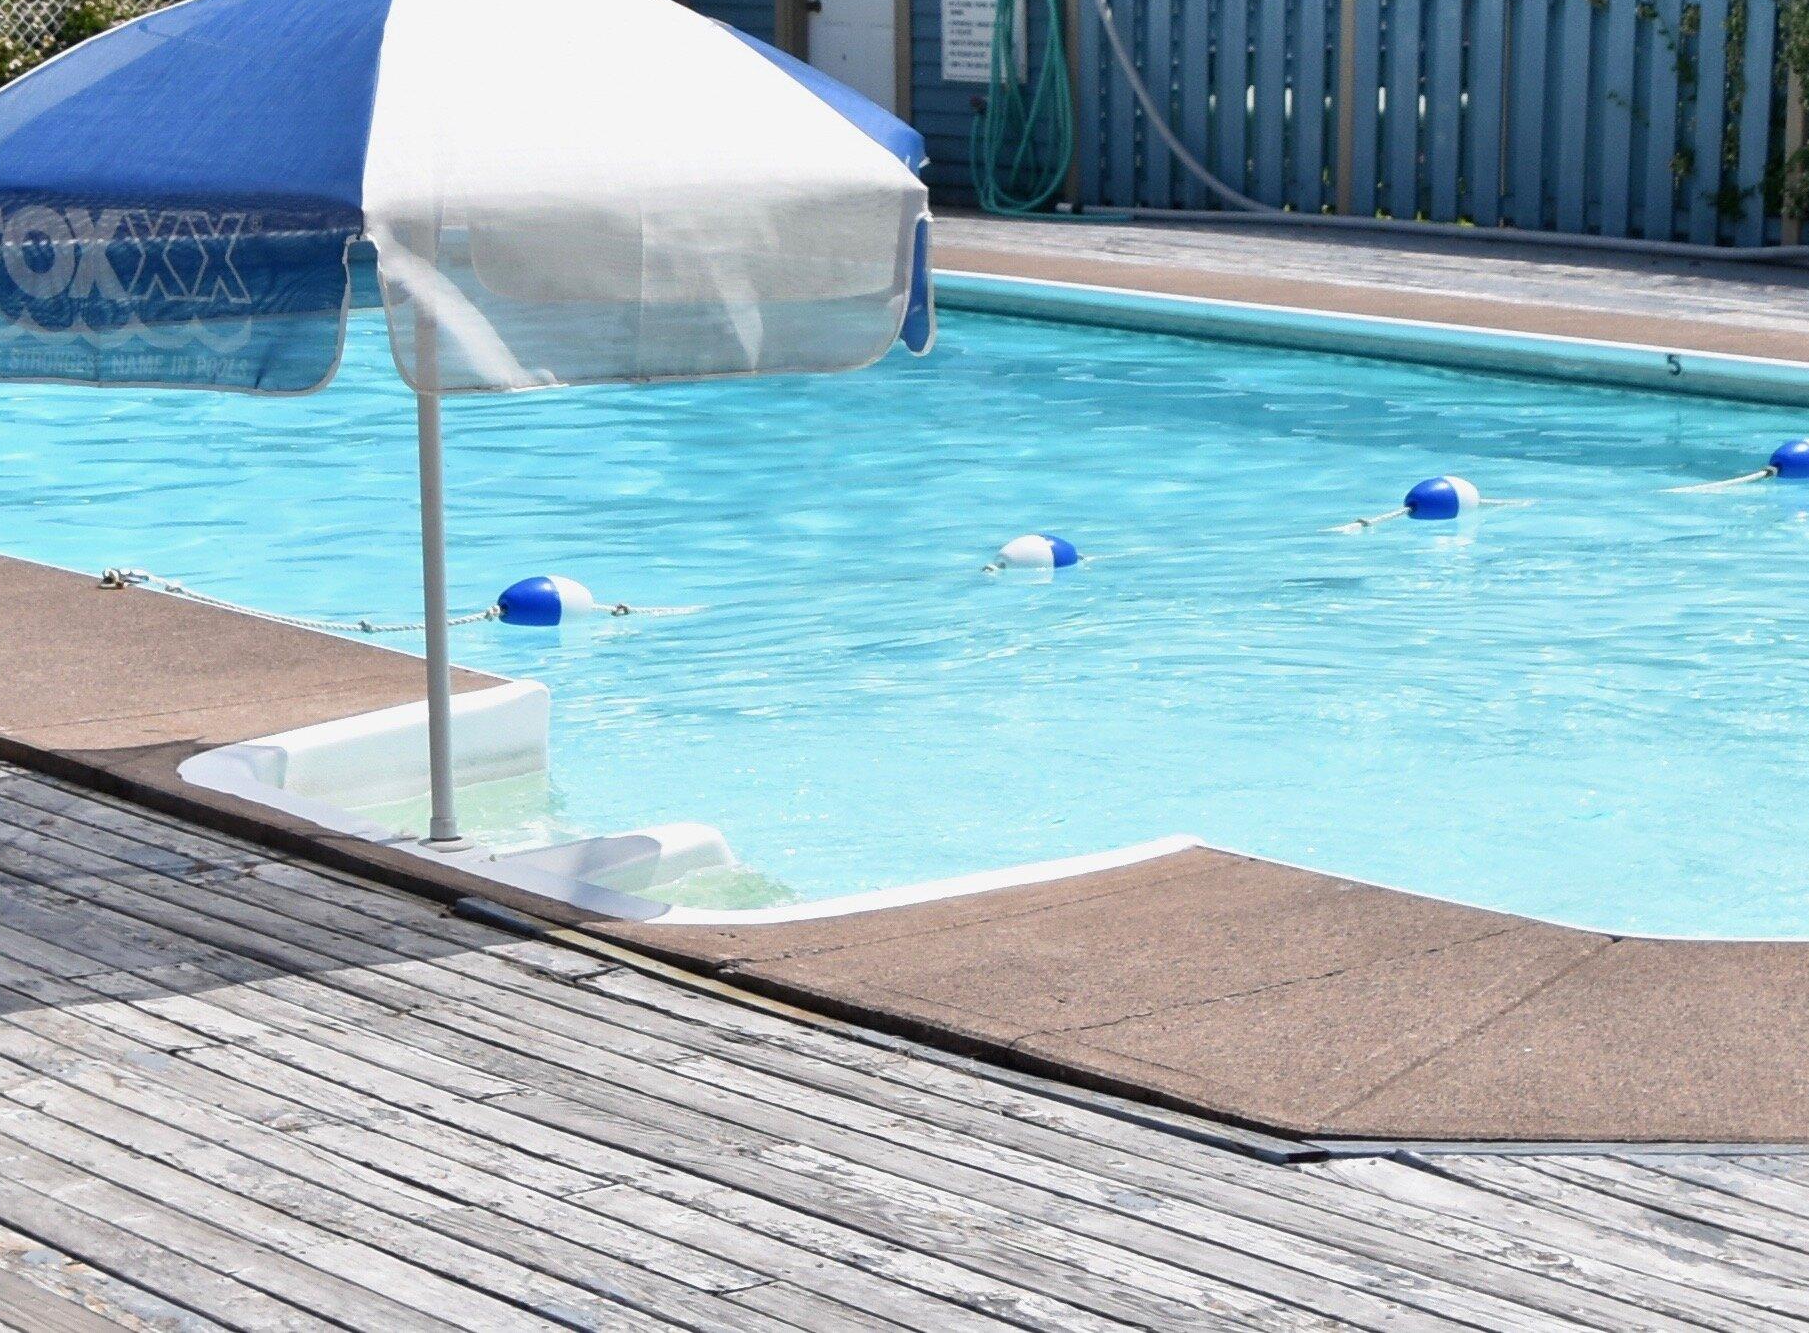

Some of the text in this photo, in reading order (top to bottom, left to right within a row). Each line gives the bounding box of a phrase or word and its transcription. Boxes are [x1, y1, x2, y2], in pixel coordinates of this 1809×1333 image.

[110, 353, 163, 375] NAME
[171, 354, 191, 376] IN
[195, 355, 249, 379] POOLS
[1666, 353, 1682, 376] 5
